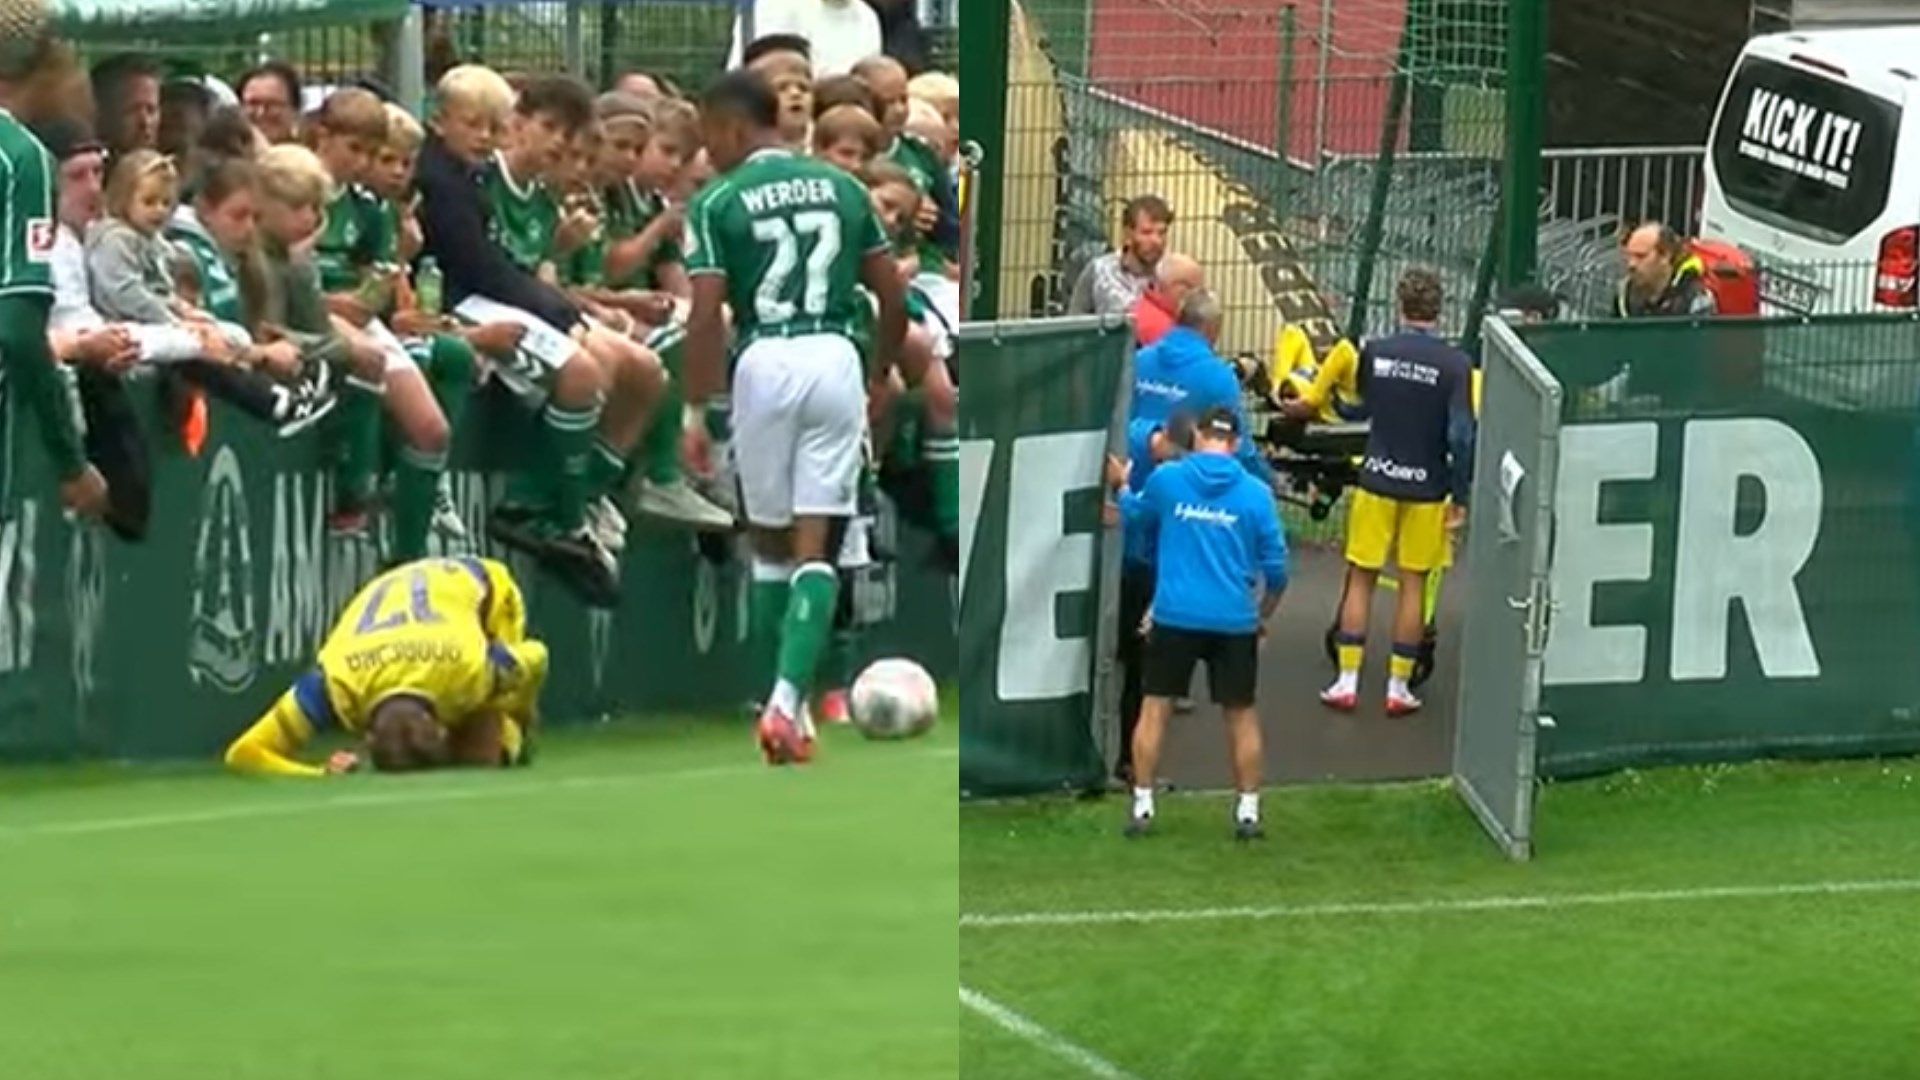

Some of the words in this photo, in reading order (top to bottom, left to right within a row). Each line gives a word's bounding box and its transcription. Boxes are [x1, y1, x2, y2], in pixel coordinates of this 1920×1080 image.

[1743, 87, 1817, 157] KICK
[1812, 111, 1862, 172] IT!
[739, 177, 839, 213] WERDER
[752, 210, 842, 325] 27
[1542, 417, 1823, 686] ER
[355, 566, 444, 635] 17
